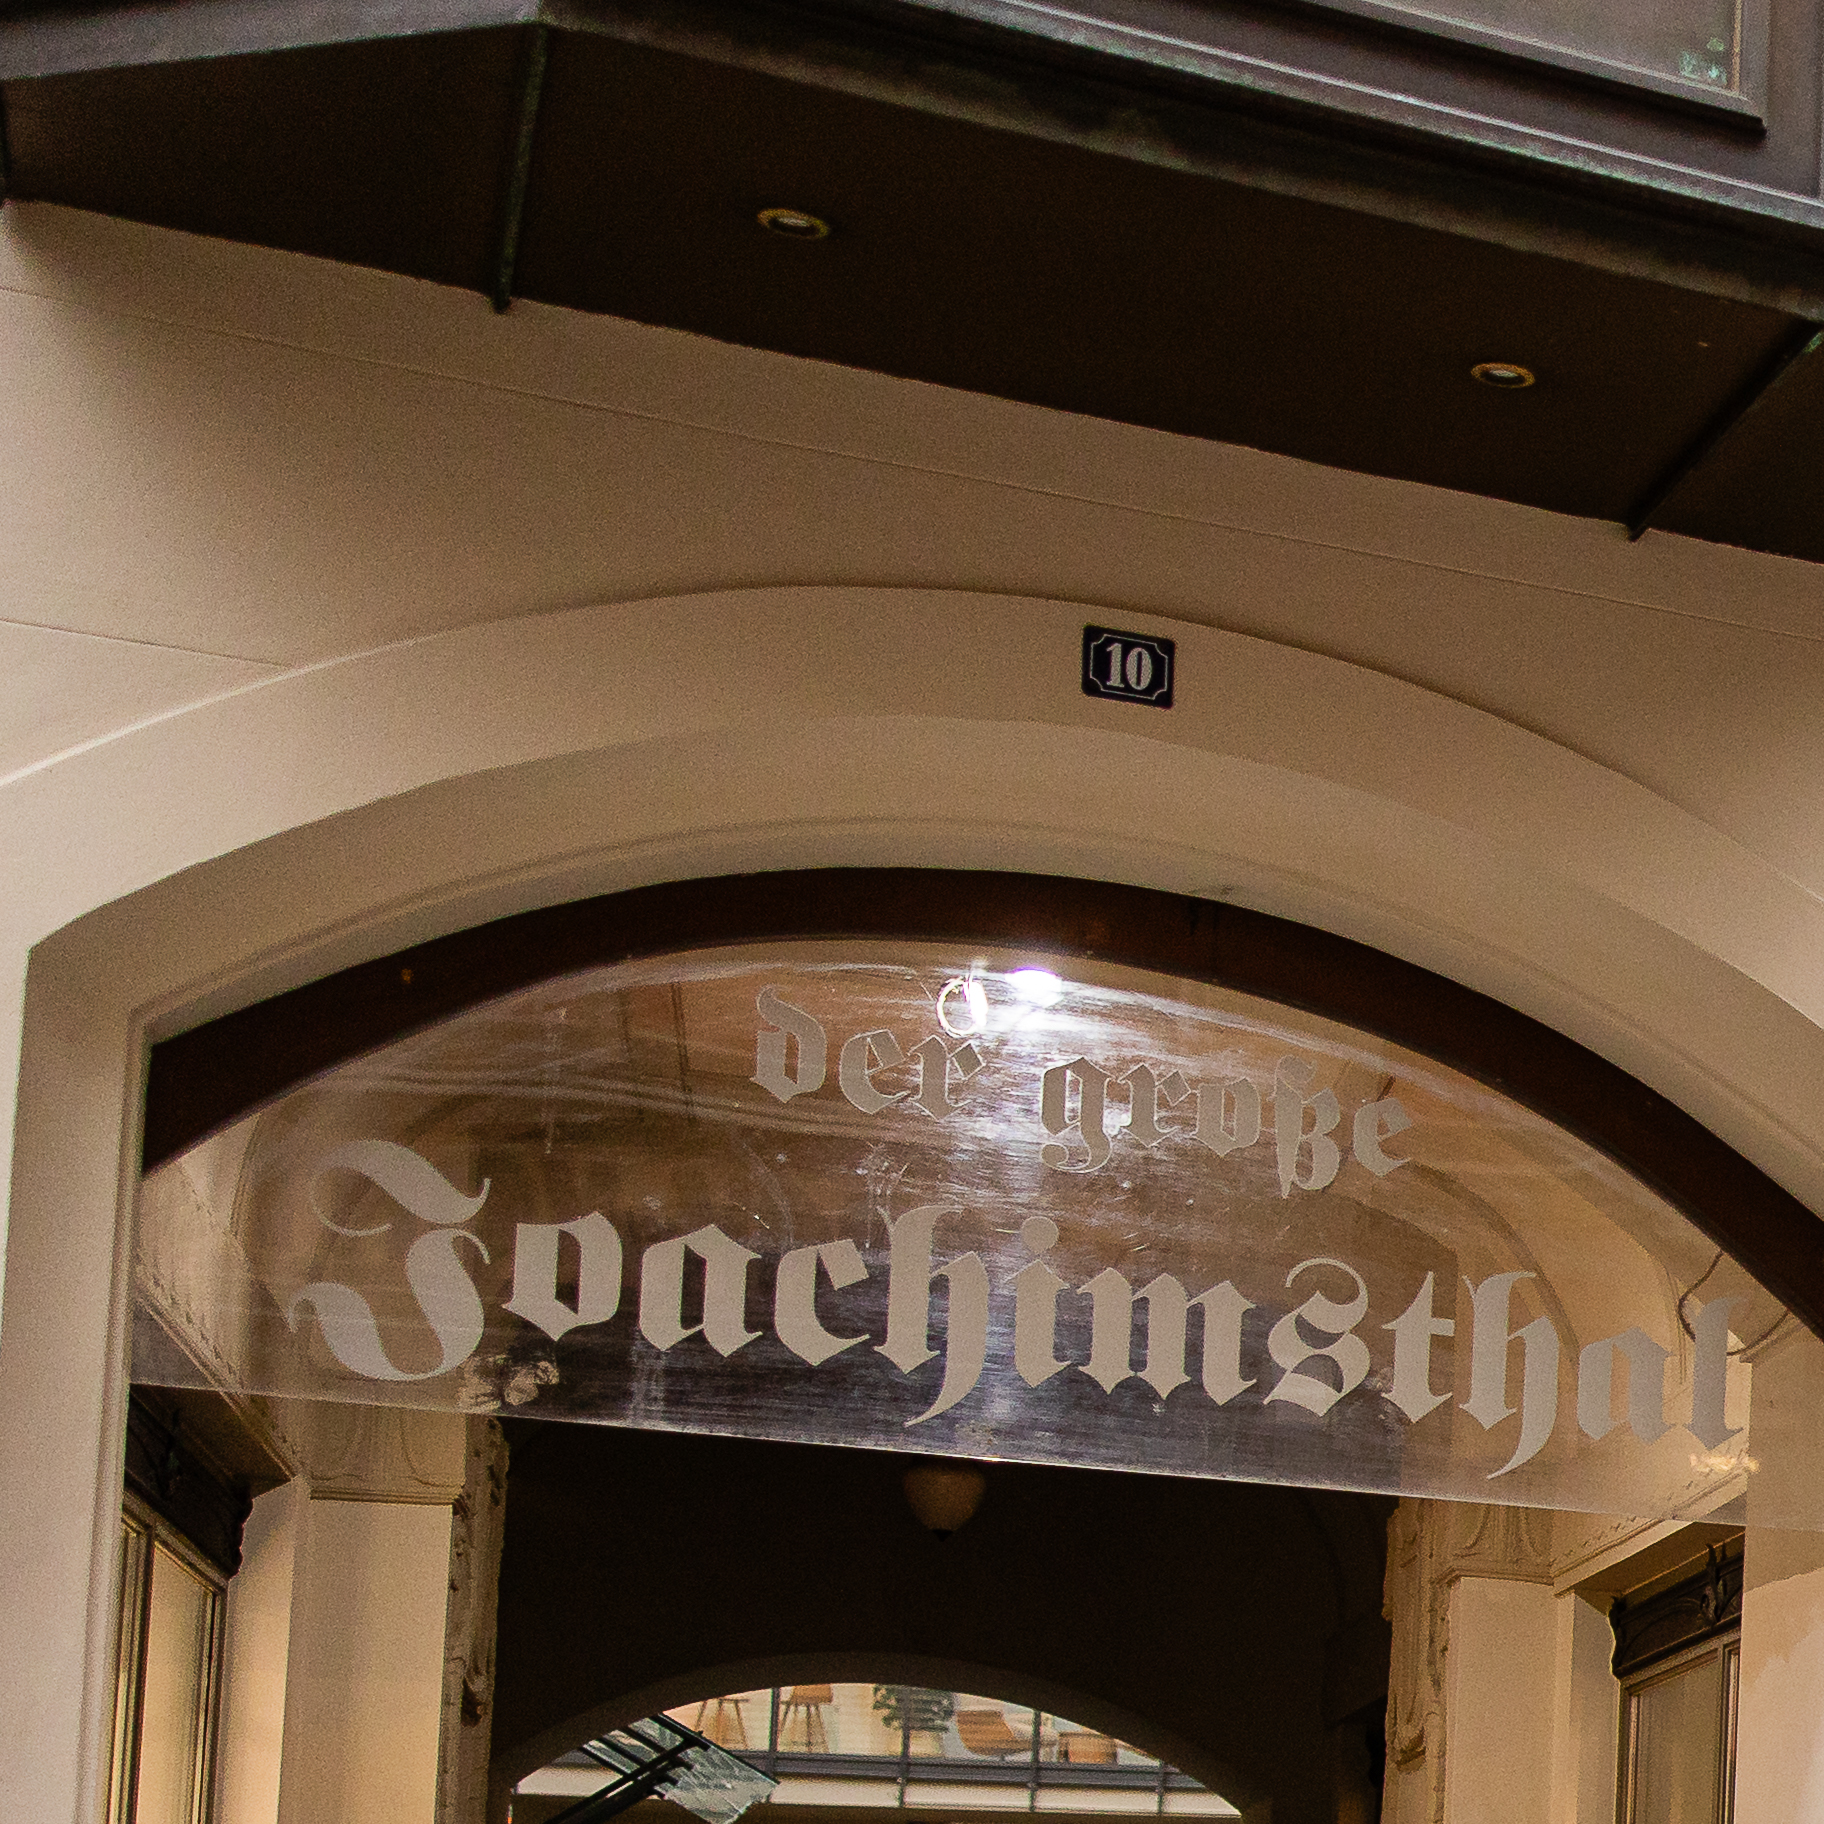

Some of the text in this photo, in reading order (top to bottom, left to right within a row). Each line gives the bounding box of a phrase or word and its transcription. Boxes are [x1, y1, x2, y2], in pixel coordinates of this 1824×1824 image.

[1105, 642, 1153, 691] 10
[749, 983, 1417, 1198] der große
